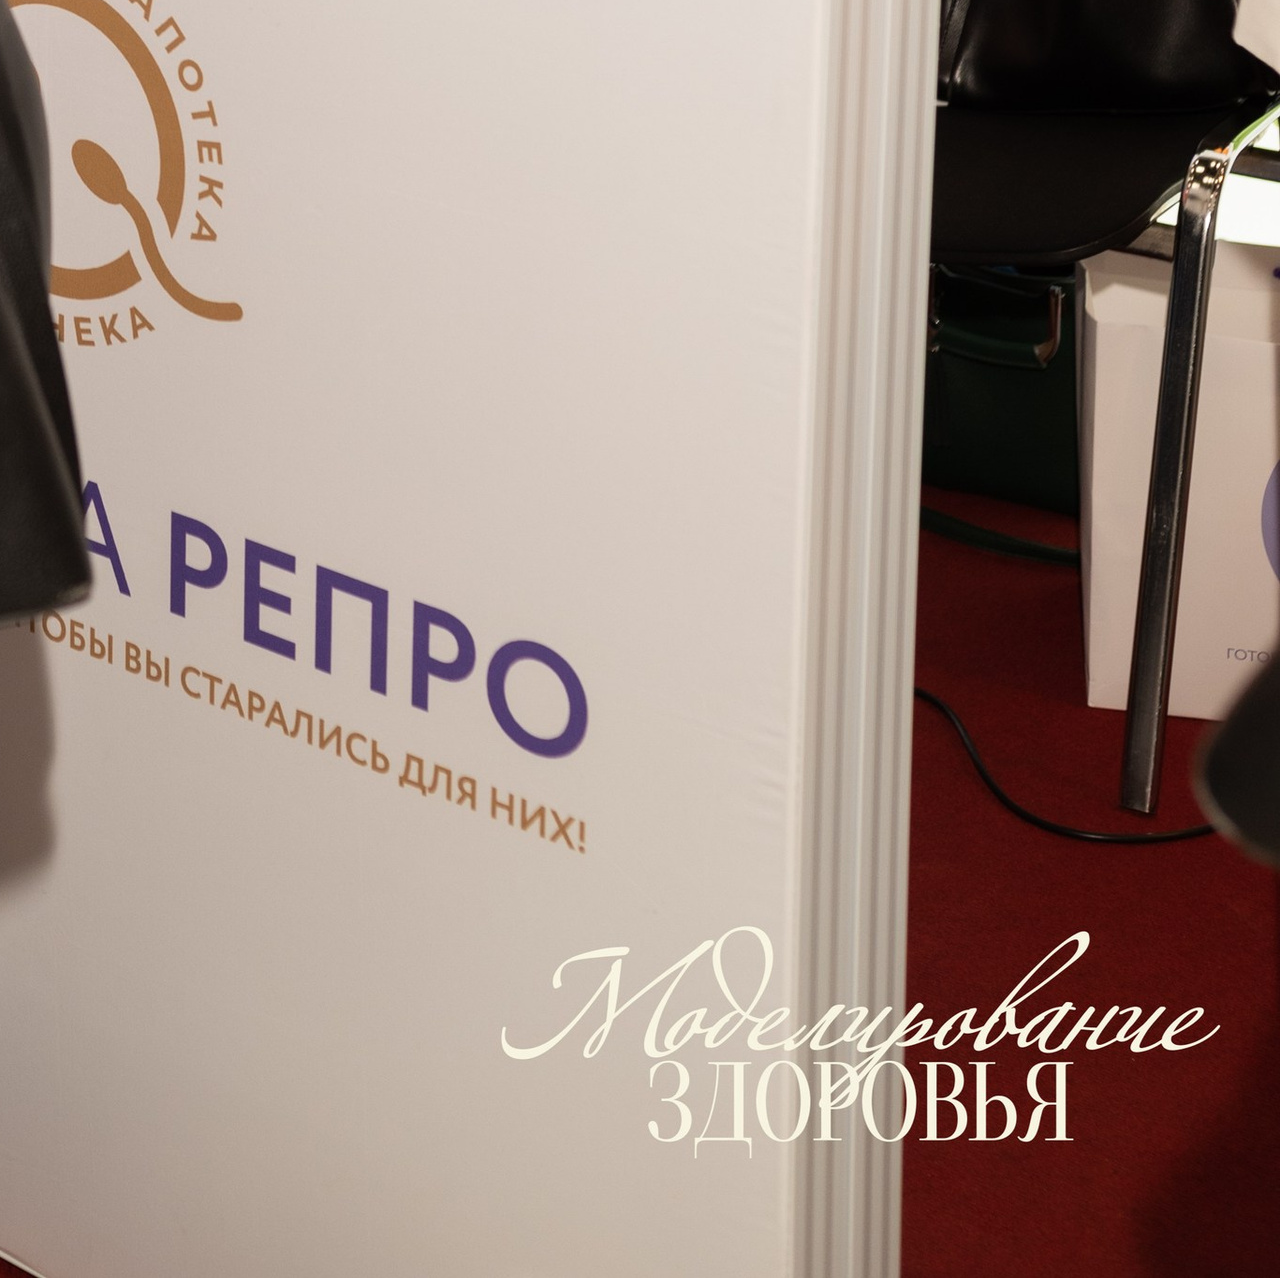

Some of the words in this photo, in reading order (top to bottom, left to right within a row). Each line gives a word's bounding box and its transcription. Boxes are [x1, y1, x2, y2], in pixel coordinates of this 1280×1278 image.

[15, 609, 113, 665] ОБЫ
[125, 640, 170, 689] ВЫ
[179, 665, 391, 776] СТАРАЛИСЬ
[398, 752, 478, 813] ДЛЯ
[490, 786, 587, 855] НИХ!
[169, 510, 590, 760] РЕПРО
[1226, 647, 1271, 664] ГОТО
